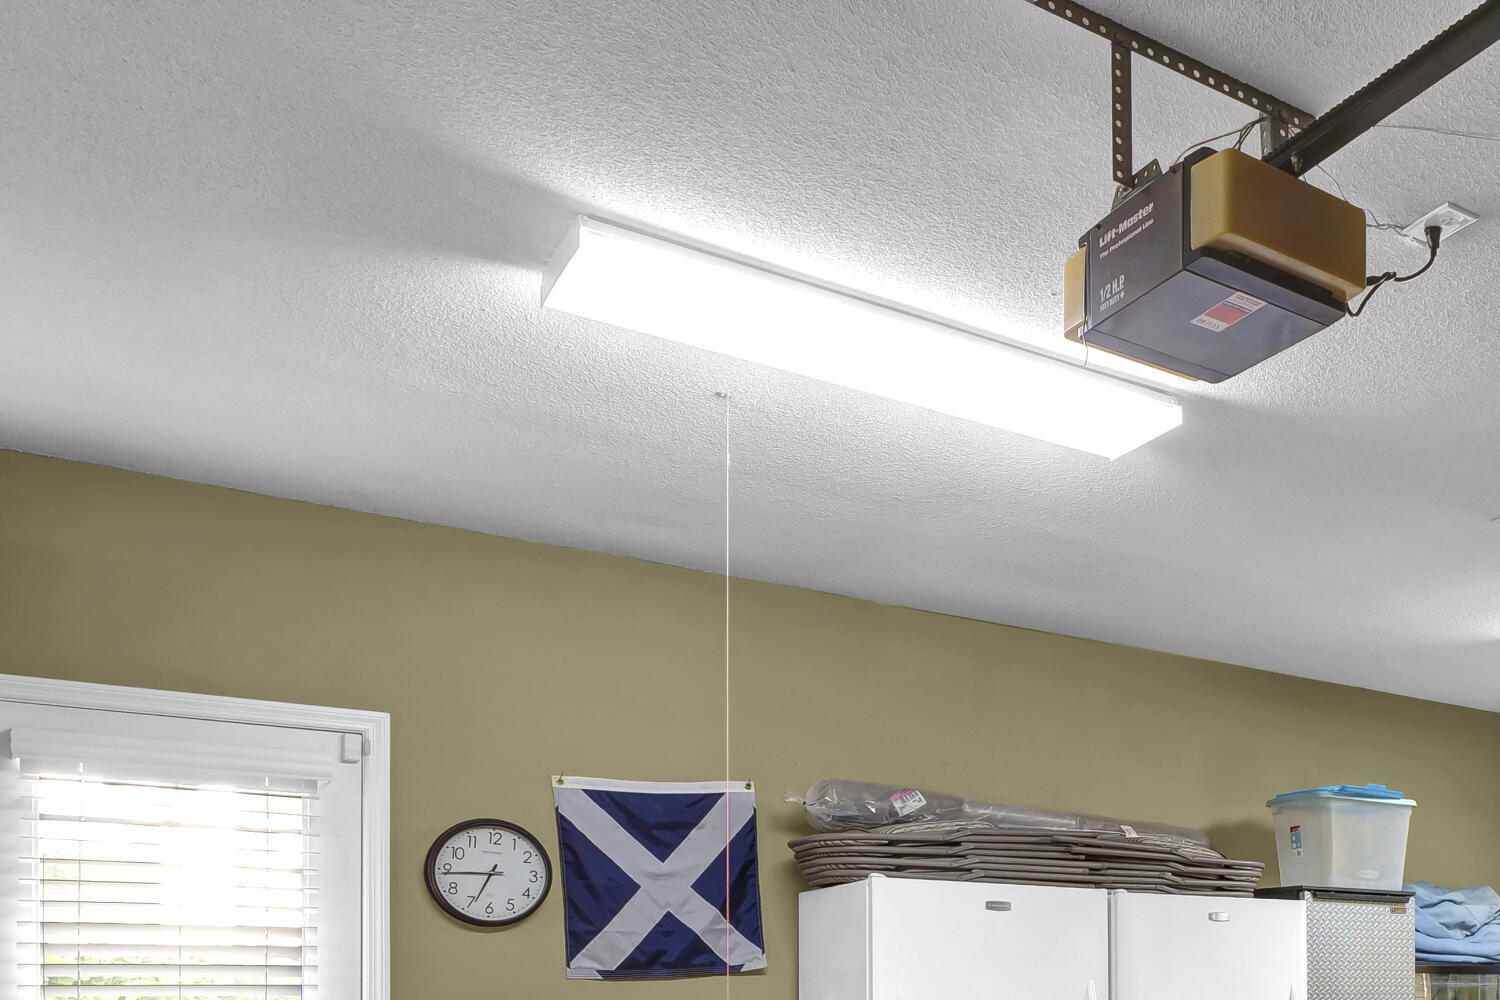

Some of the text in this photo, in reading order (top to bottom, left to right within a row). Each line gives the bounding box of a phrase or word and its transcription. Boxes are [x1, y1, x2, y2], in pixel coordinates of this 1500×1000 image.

[1099, 202, 1154, 248] Lift-Master
[1100, 283, 1111, 302] 1/2
[488, 831, 502, 845] 12
[451, 847, 465, 860] 10
[523, 851, 532, 864] 2
[443, 862, 452, 875] 9
[529, 870, 538, 883] 3
[448, 881, 458, 895] 8
[522, 887, 530, 899] 4
[467, 896, 475, 908] 7
[485, 901, 494, 914] 6
[506, 898, 515, 911] 5
